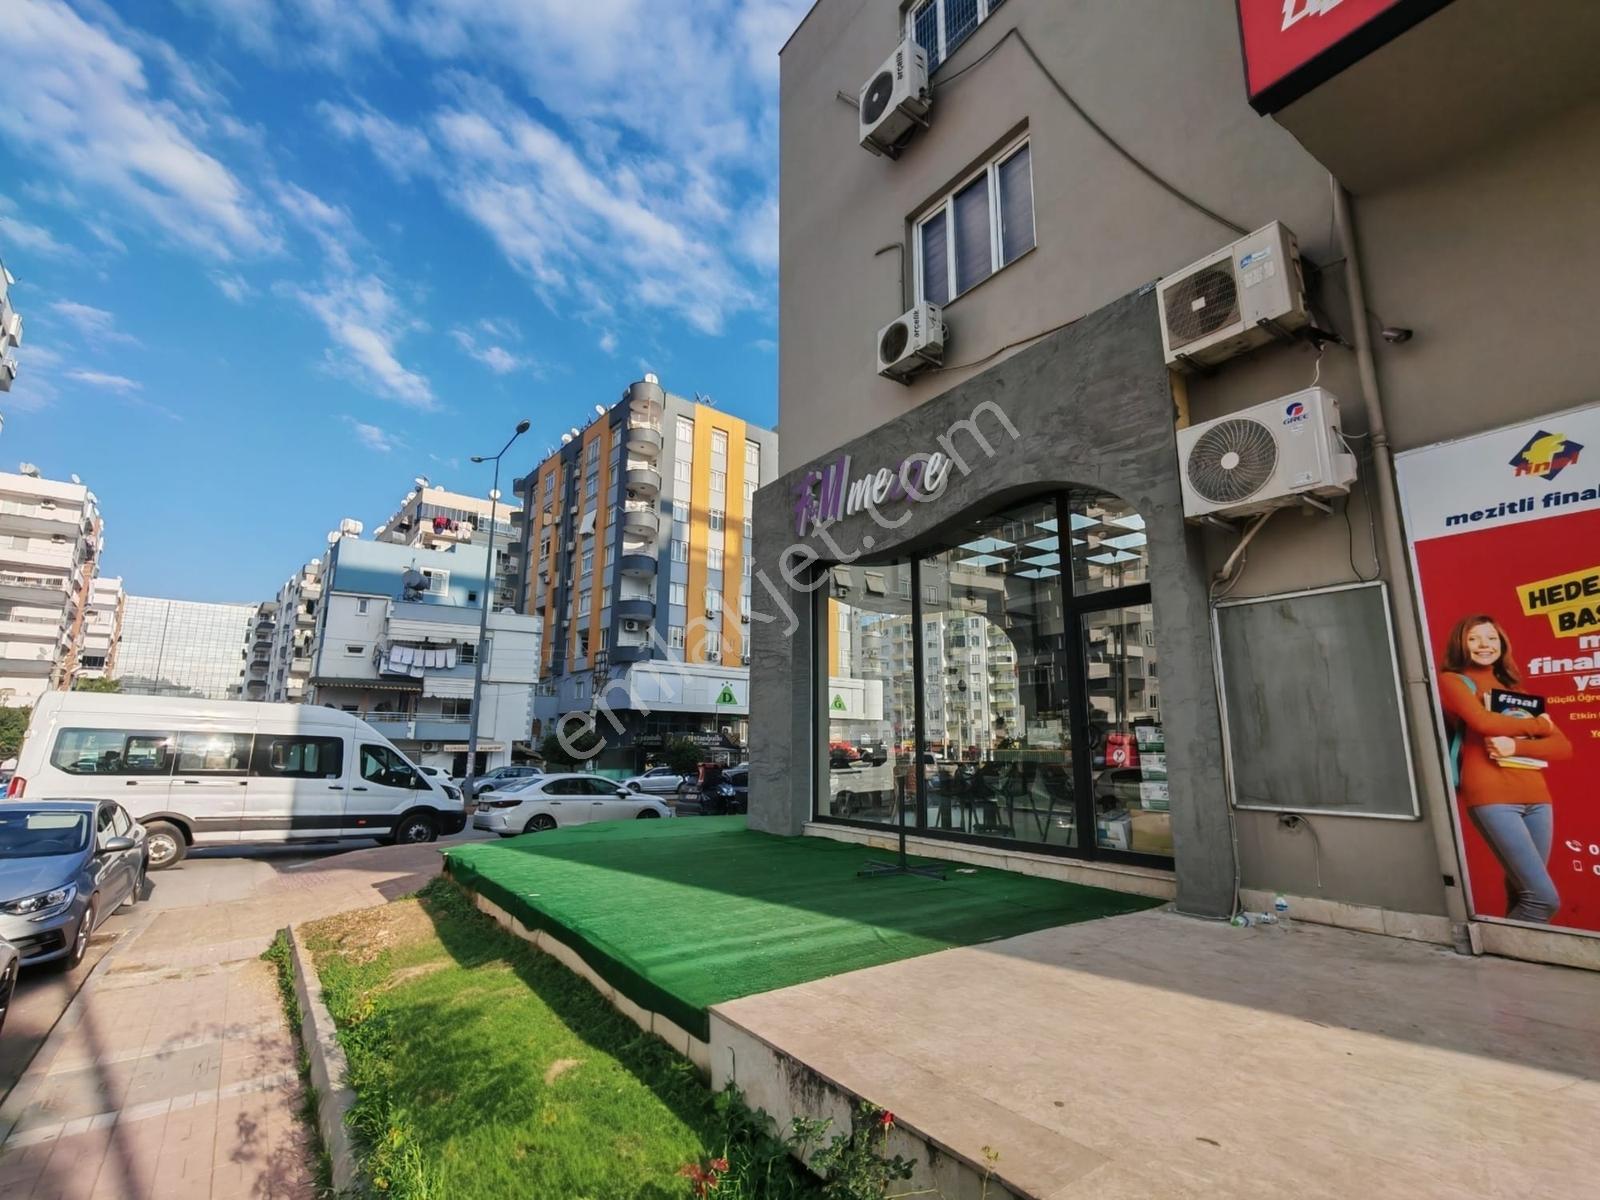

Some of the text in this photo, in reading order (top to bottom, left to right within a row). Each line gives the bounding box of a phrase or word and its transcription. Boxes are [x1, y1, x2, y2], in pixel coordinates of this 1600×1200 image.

[1445, 484, 1600, 527] mezitli fina
[1528, 575, 1600, 609] HEDE
[1558, 604, 1600, 631] BA
[1528, 651, 1600, 675] final
[1570, 711, 1597, 721] Etkin
